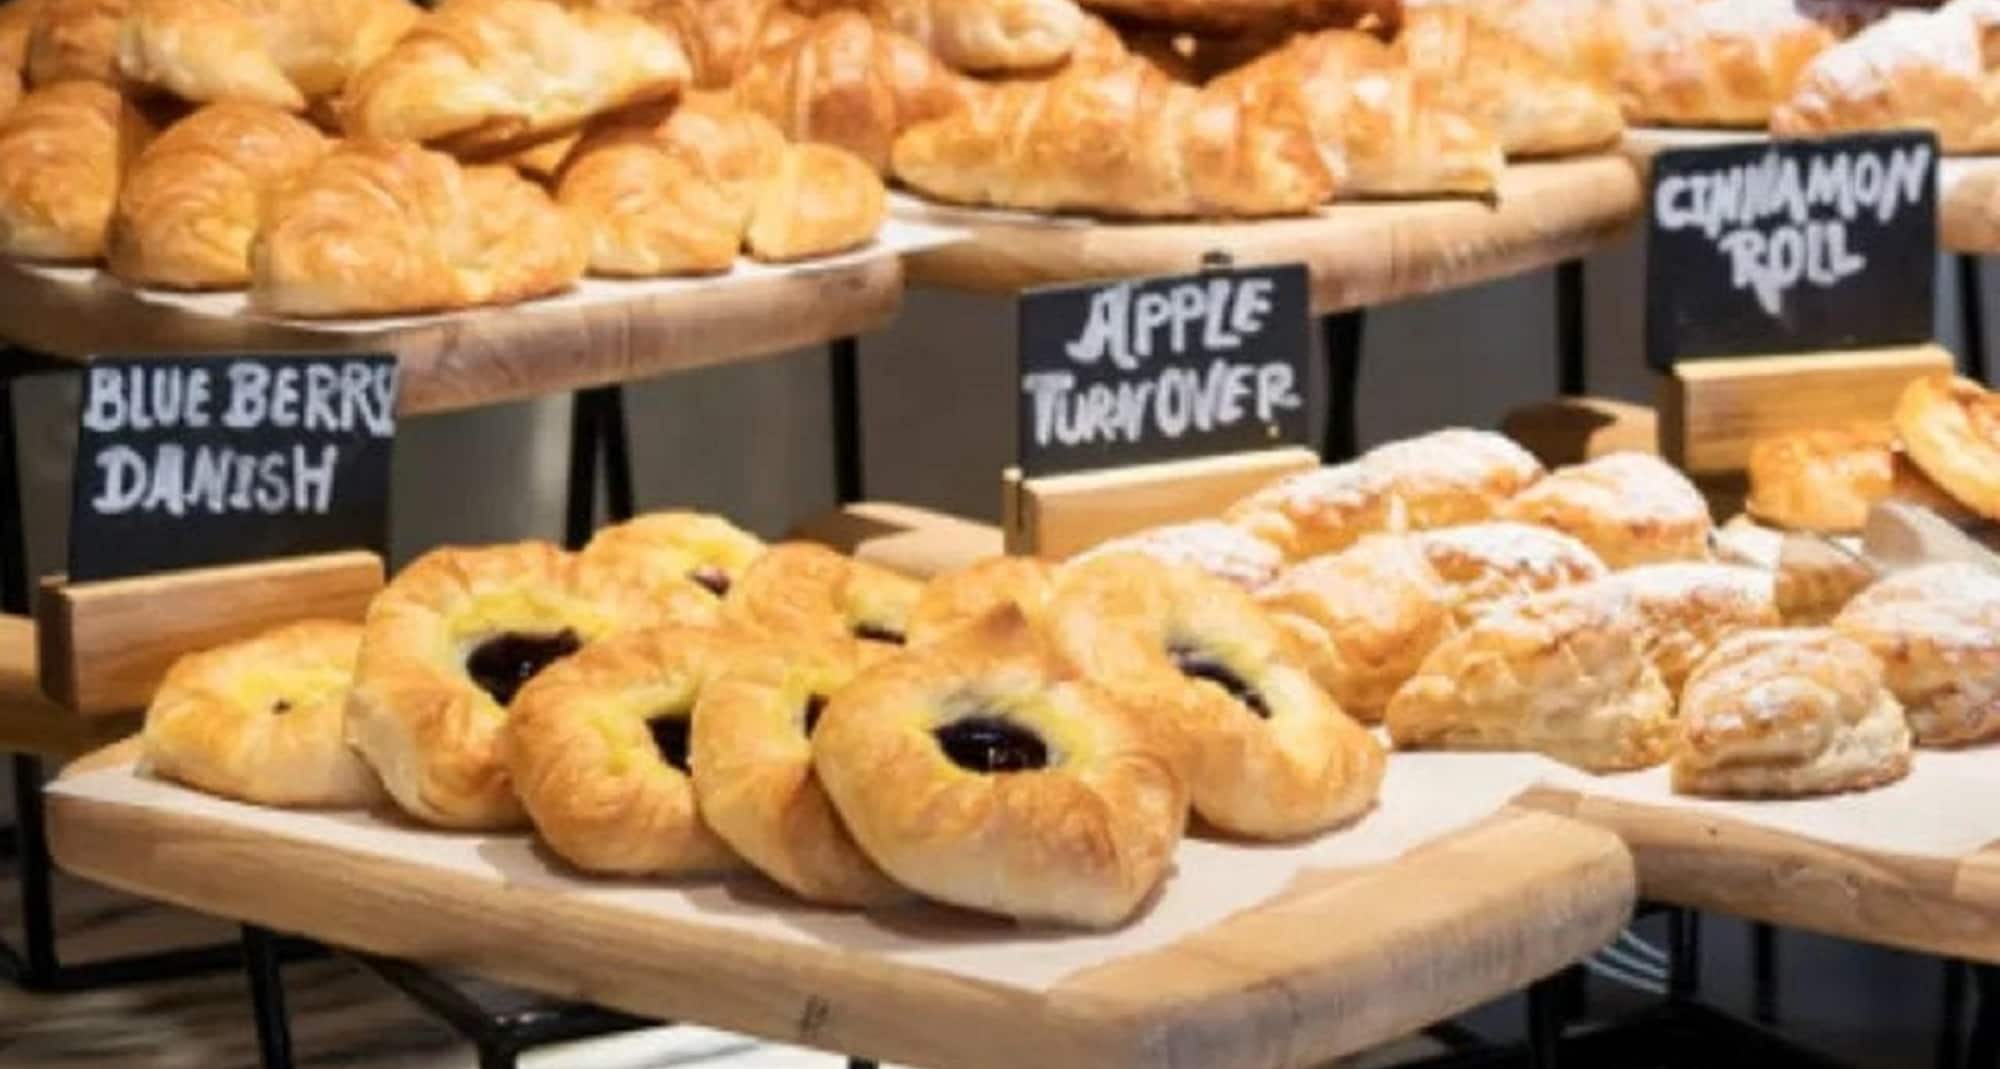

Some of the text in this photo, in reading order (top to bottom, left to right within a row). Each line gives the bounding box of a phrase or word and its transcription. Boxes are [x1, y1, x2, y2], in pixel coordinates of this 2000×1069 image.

[1655, 144, 1930, 238] CINNAMON
[1717, 217, 1867, 315] ROLL
[1066, 278, 1273, 369] APPLE
[83, 362, 396, 437] BLUE BERRY
[92, 444, 337, 515] DANISH
